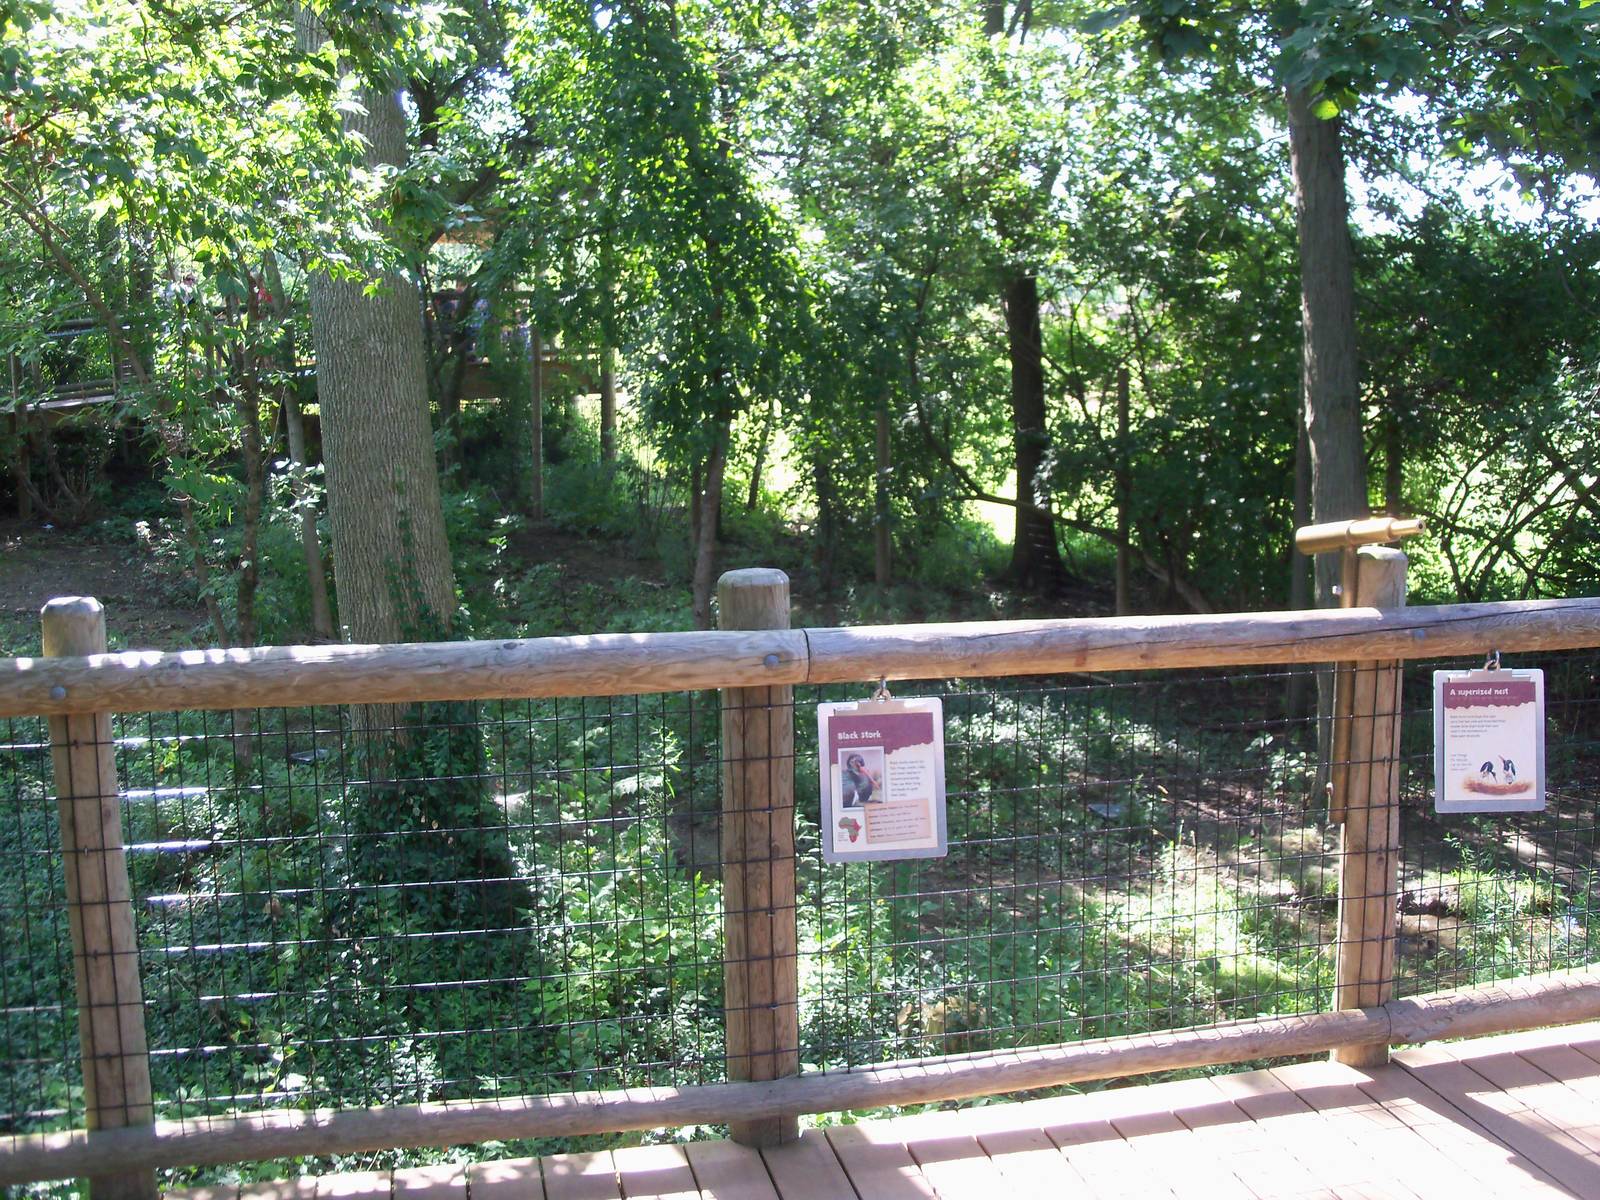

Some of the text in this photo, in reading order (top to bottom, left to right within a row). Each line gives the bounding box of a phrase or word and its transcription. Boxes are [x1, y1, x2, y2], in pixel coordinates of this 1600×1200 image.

[1449, 687, 1509, 697] A supersized nest
[837, 730, 859, 741] Black
